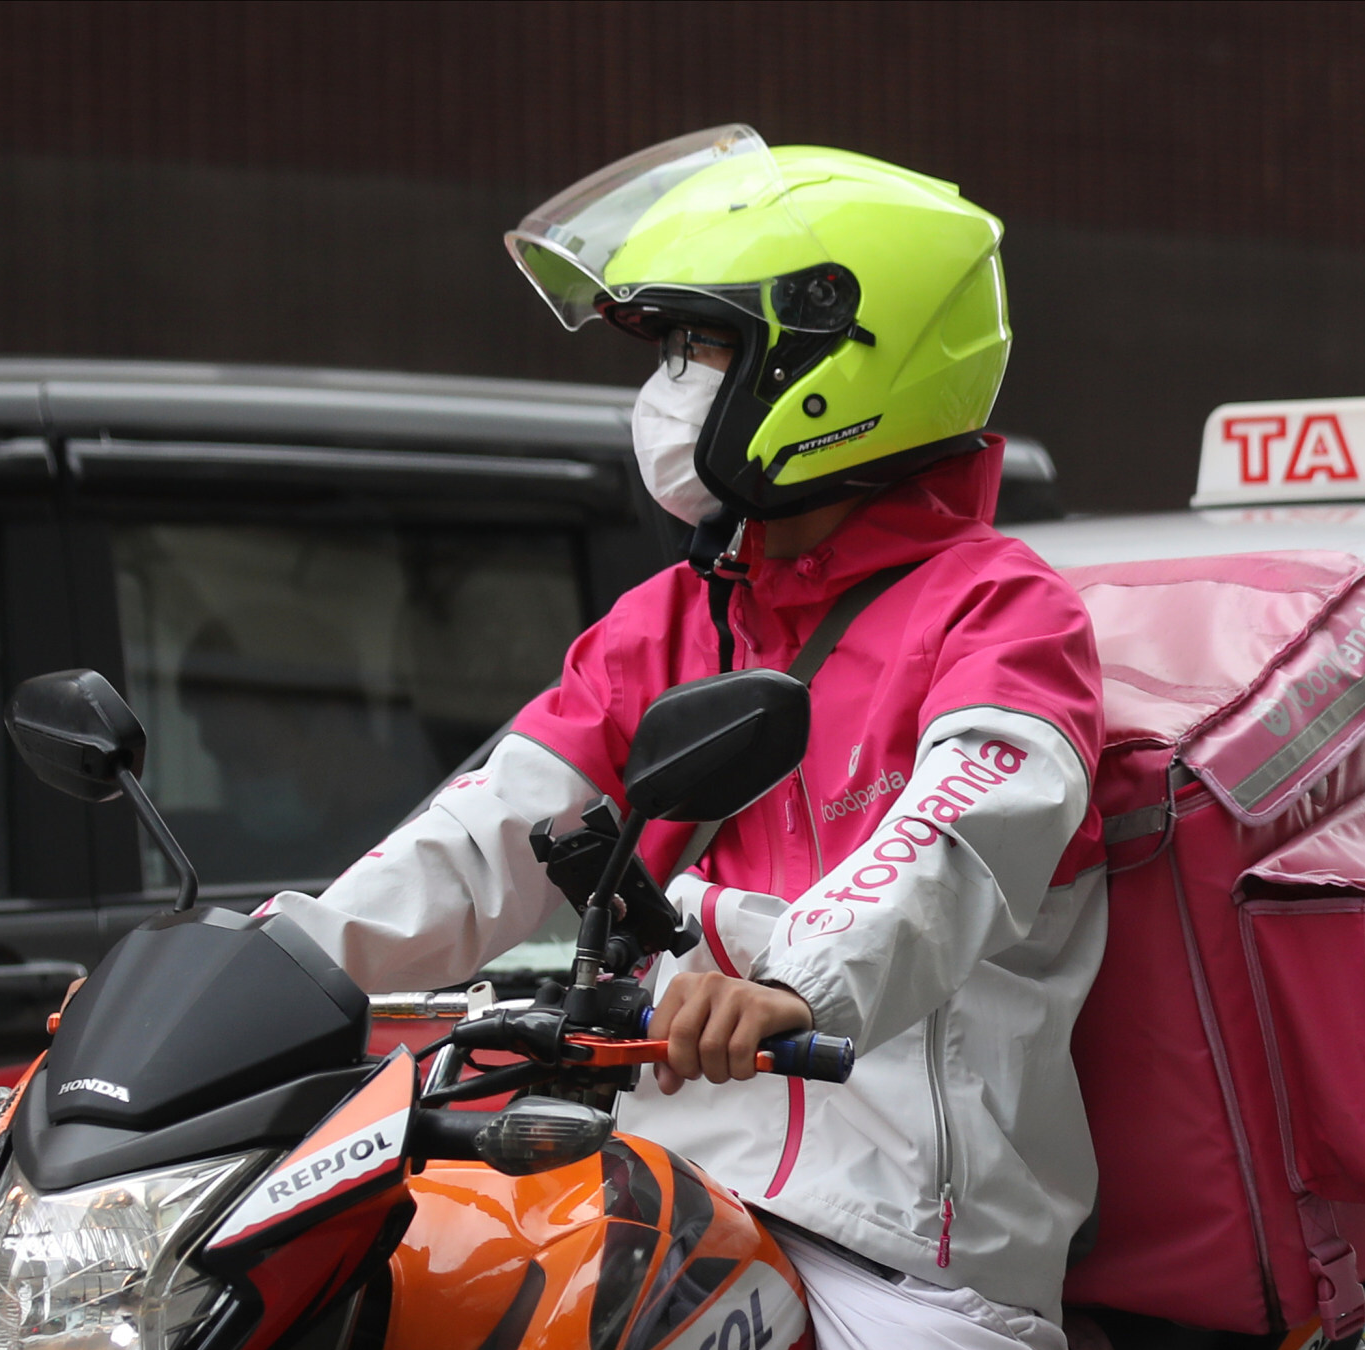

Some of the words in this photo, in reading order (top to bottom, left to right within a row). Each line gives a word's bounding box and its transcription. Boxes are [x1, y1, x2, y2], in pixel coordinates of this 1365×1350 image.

[824, 740, 1029, 903] foodanda
[58, 1077, 131, 1103] HONDA
[267, 1132, 392, 1204] REPSOL
